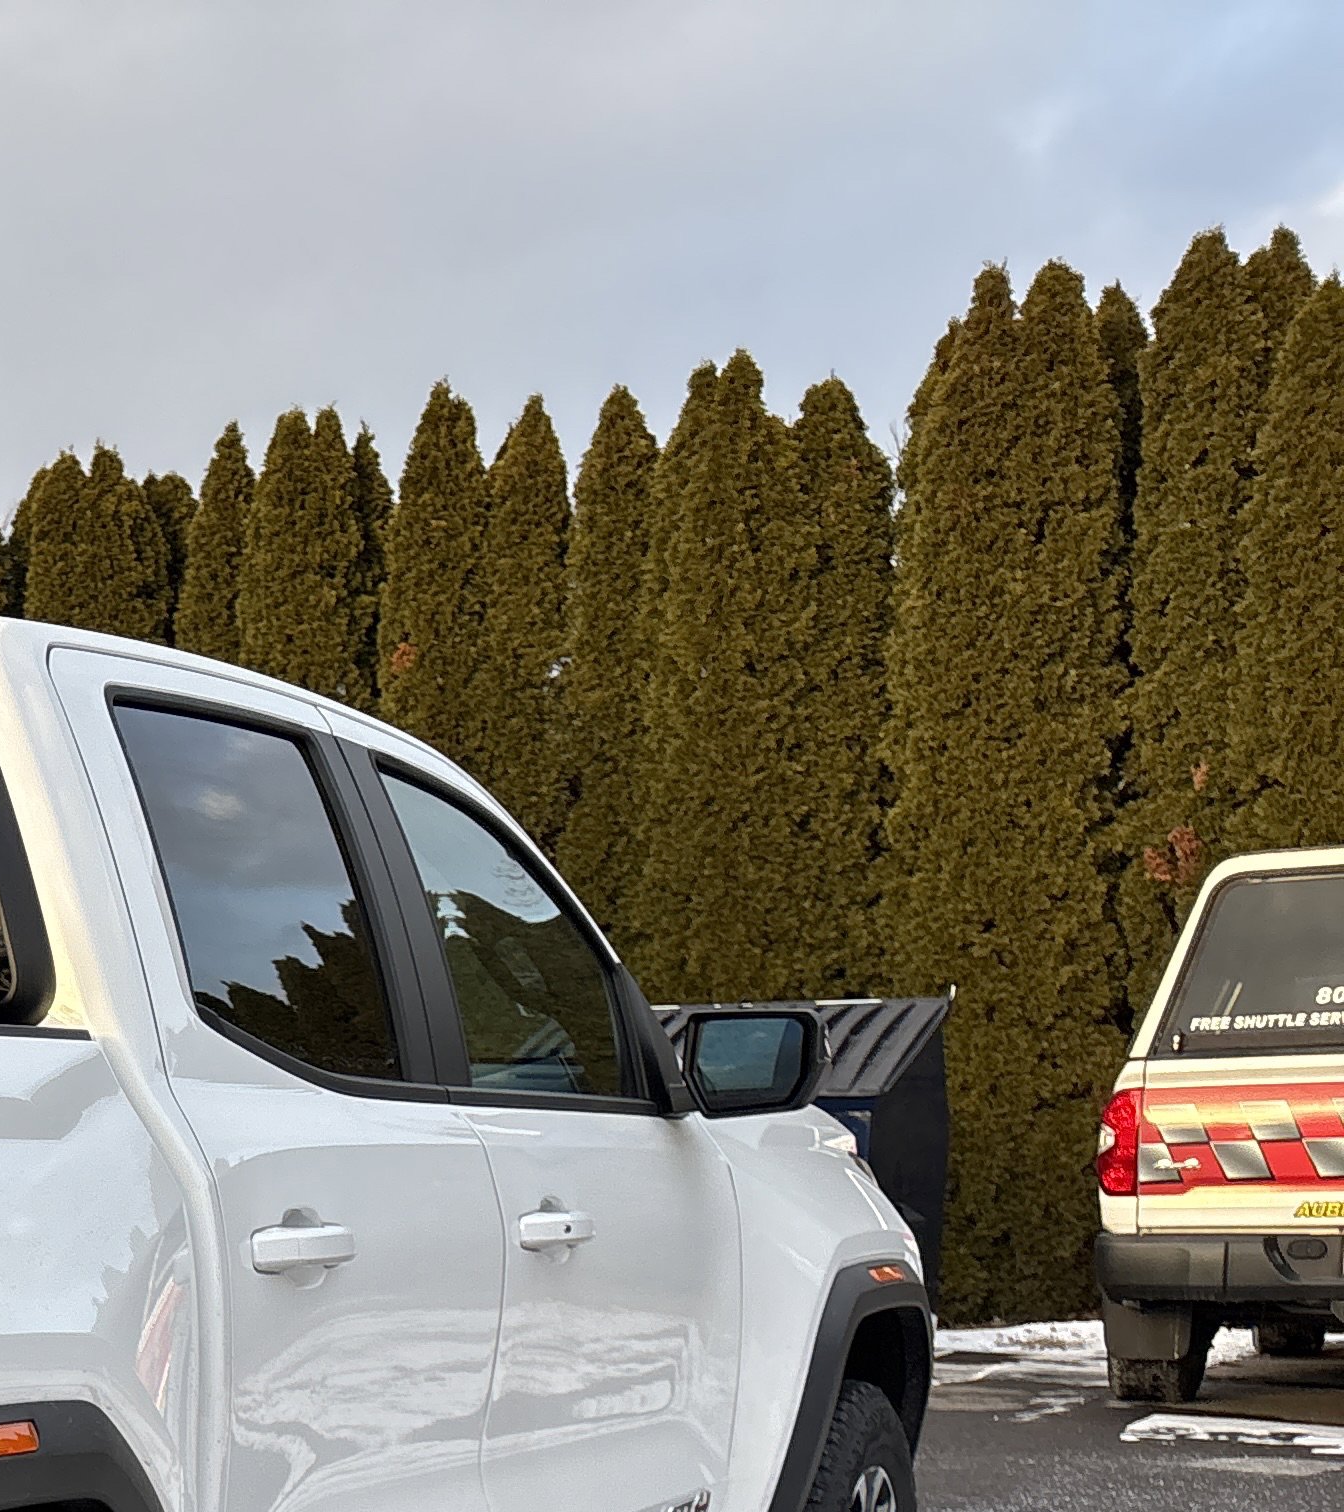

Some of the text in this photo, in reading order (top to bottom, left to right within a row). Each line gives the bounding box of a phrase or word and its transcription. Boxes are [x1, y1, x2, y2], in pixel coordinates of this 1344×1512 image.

[1190, 1010, 1344, 1032] FREE SHUTTLE SER
[1293, 1201, 1344, 1218] AUB
